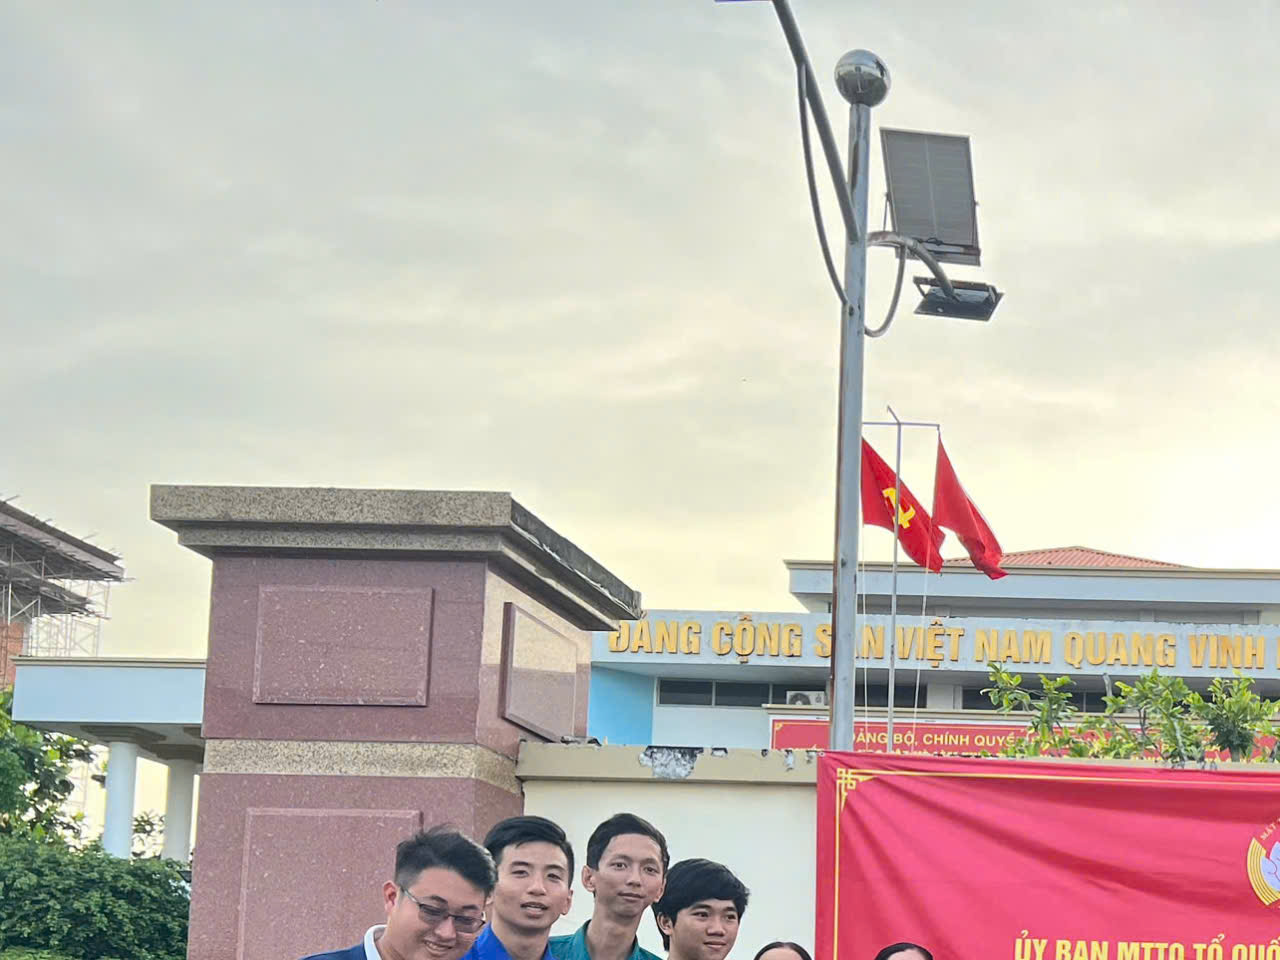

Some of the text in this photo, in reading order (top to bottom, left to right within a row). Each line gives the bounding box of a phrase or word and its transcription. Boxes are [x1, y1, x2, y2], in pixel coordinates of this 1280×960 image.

[711, 616, 803, 664] CỘNG
[814, 623, 885, 659] SN
[896, 620, 965, 668] VIỆT
[975, 628, 1052, 664] NAM
[1063, 631, 1177, 669] QUANG
[1188, 633, 1265, 669] VINH
[853, 728, 888, 744] ẢNG
[893, 730, 918, 747] BỘ,
[923, 731, 970, 746] CHÍNH
